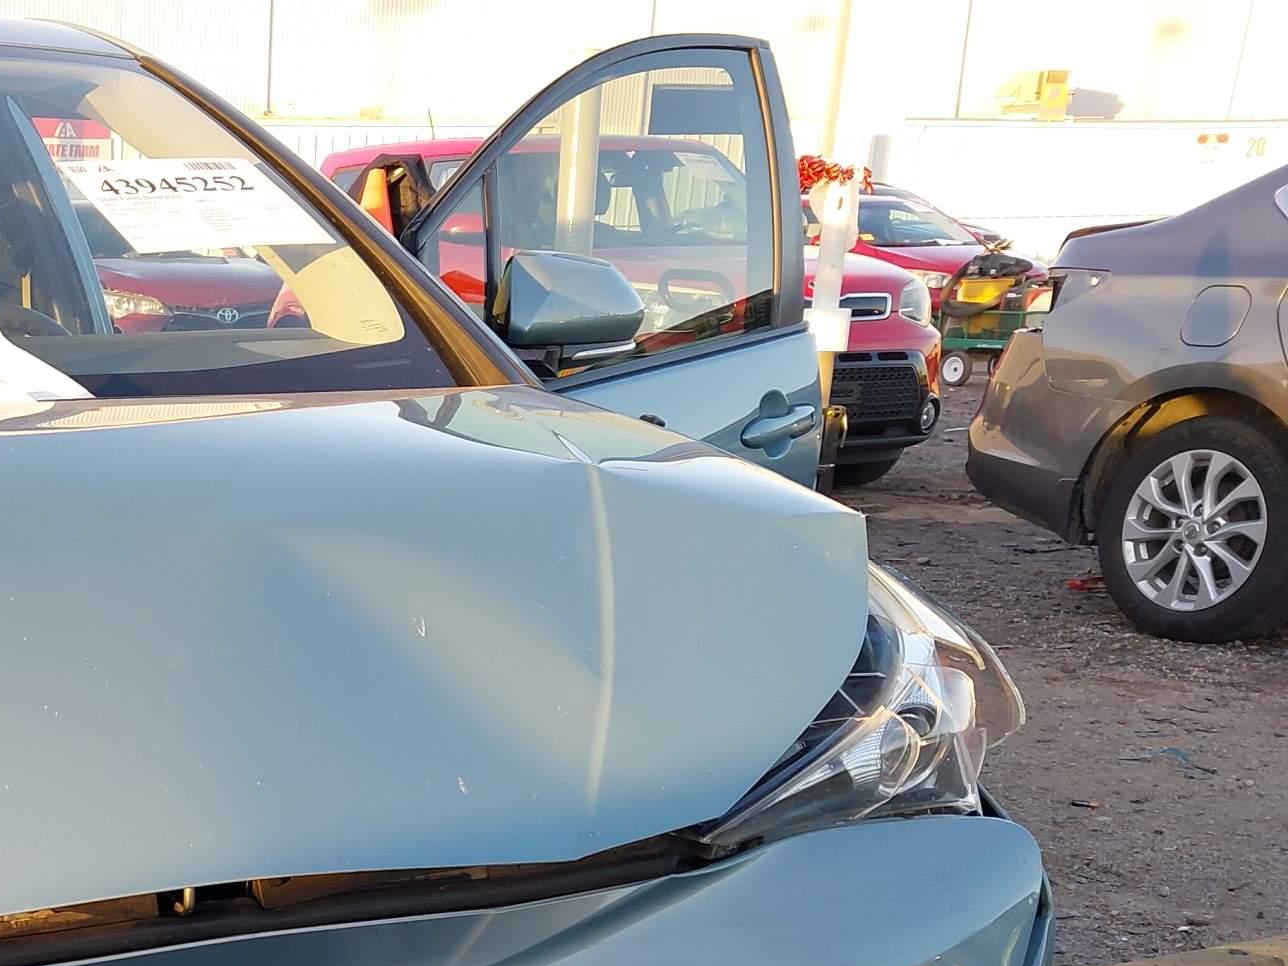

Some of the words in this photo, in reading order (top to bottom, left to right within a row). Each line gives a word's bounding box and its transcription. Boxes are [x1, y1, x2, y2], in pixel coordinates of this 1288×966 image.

[46, 143, 68, 158] ATE
[69, 143, 100, 159] FARM
[1245, 136, 1267, 158] 20
[101, 175, 254, 195] 43945252
